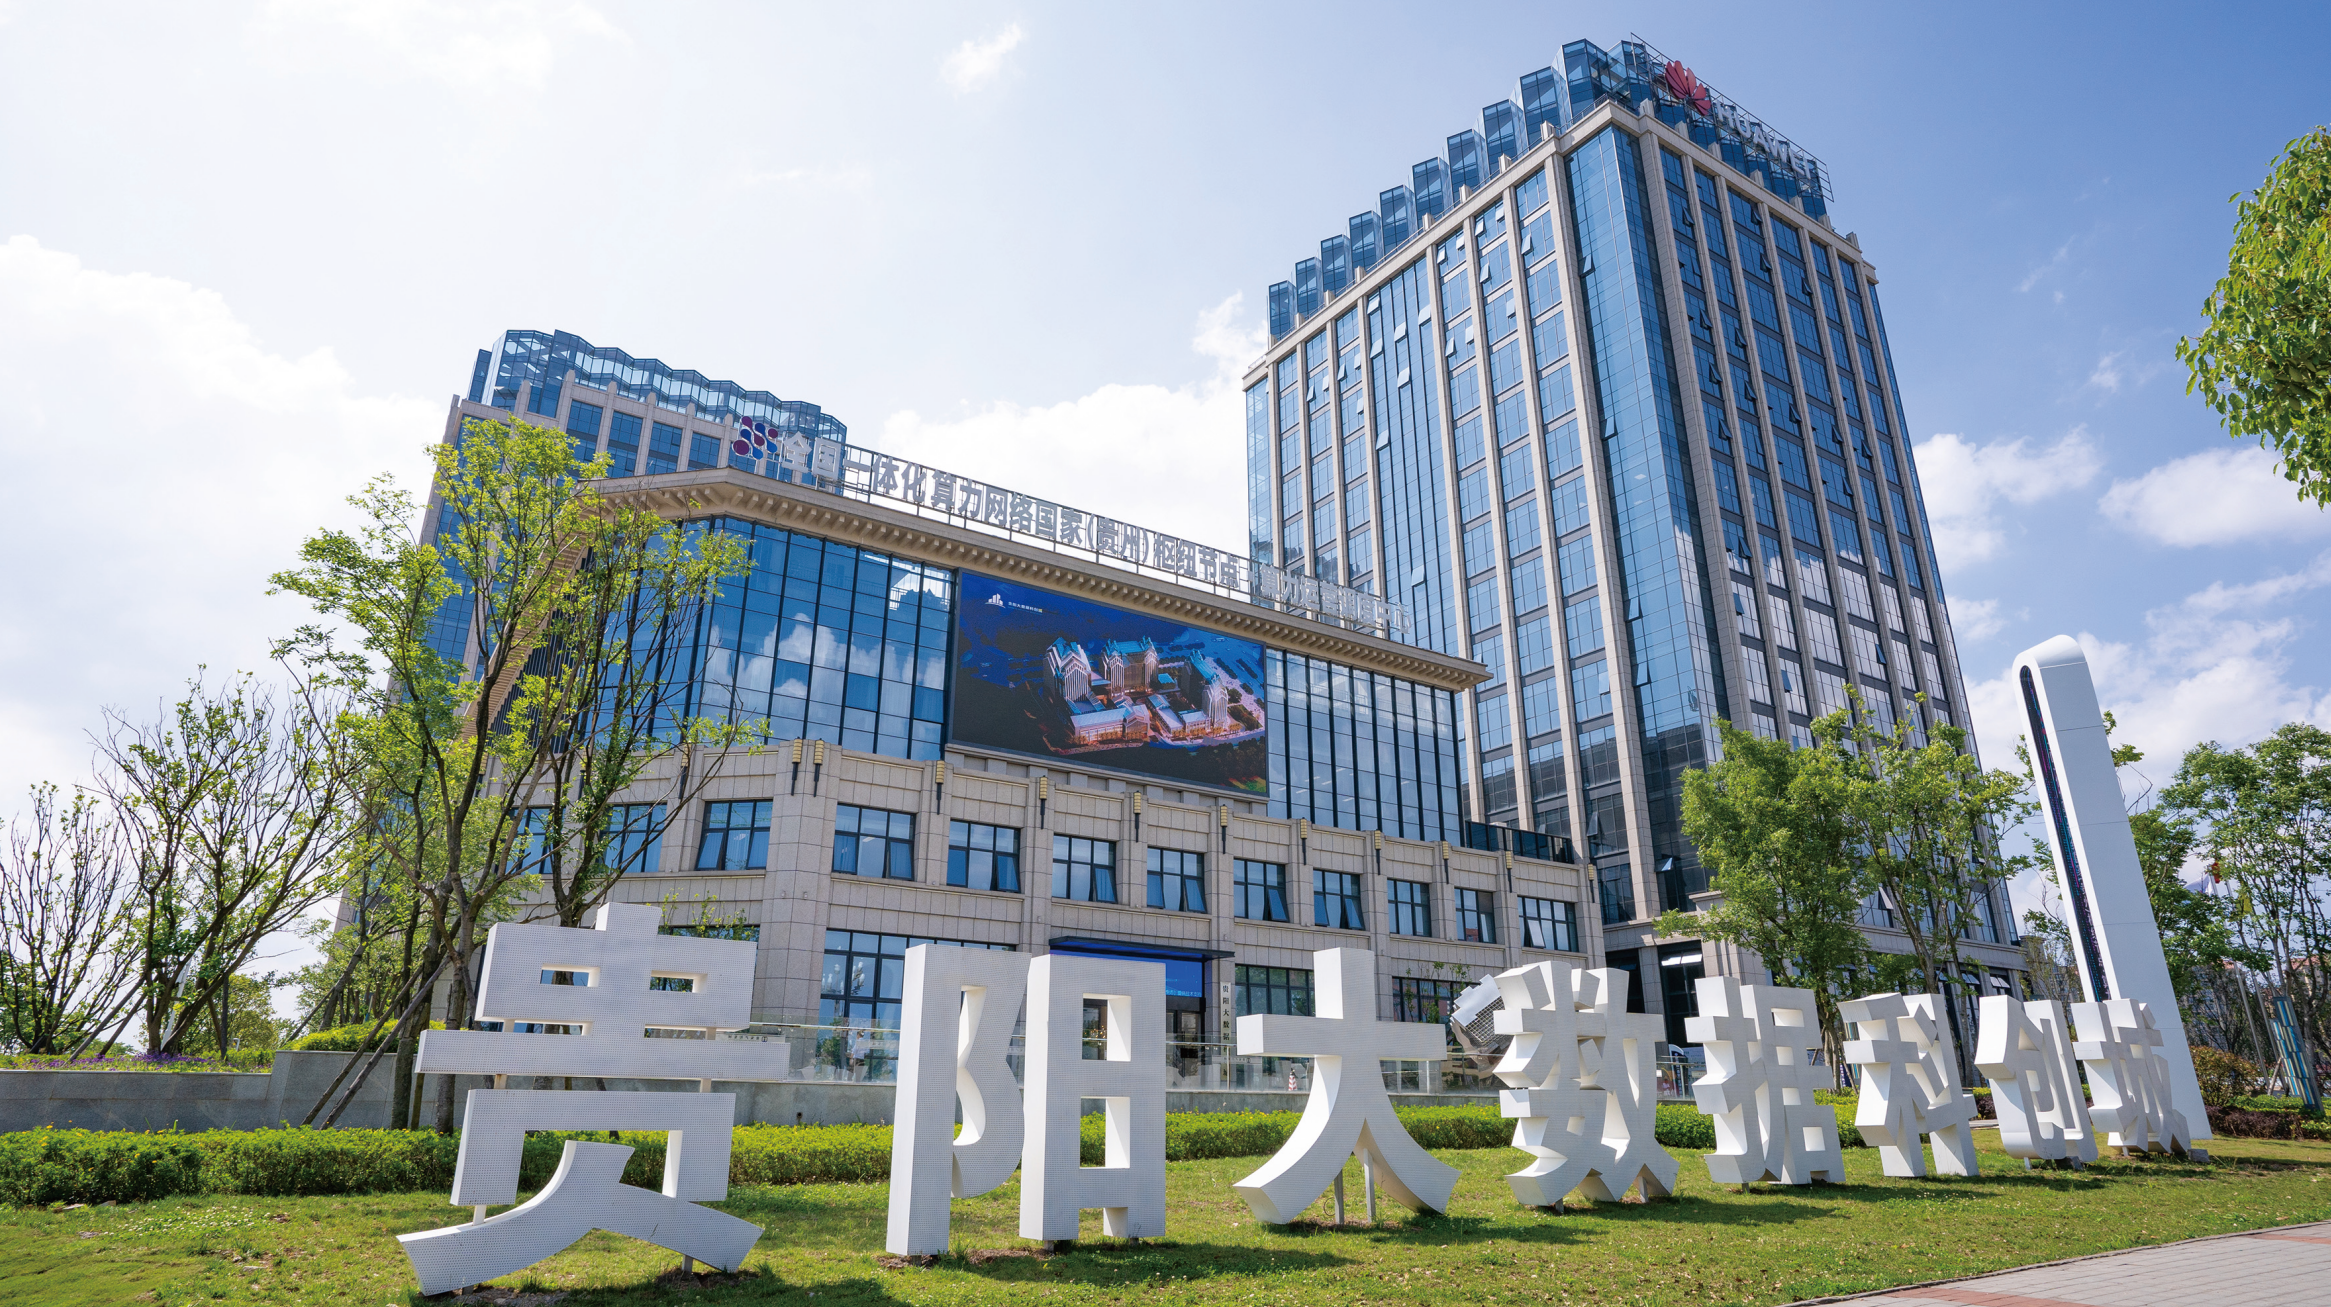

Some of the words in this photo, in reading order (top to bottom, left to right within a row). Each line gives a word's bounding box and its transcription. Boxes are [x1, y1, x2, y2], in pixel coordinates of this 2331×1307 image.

[1715, 100, 1811, 180] HUAWEI
[397, 902, 2191, 1297] 贵阳大数据科创城
